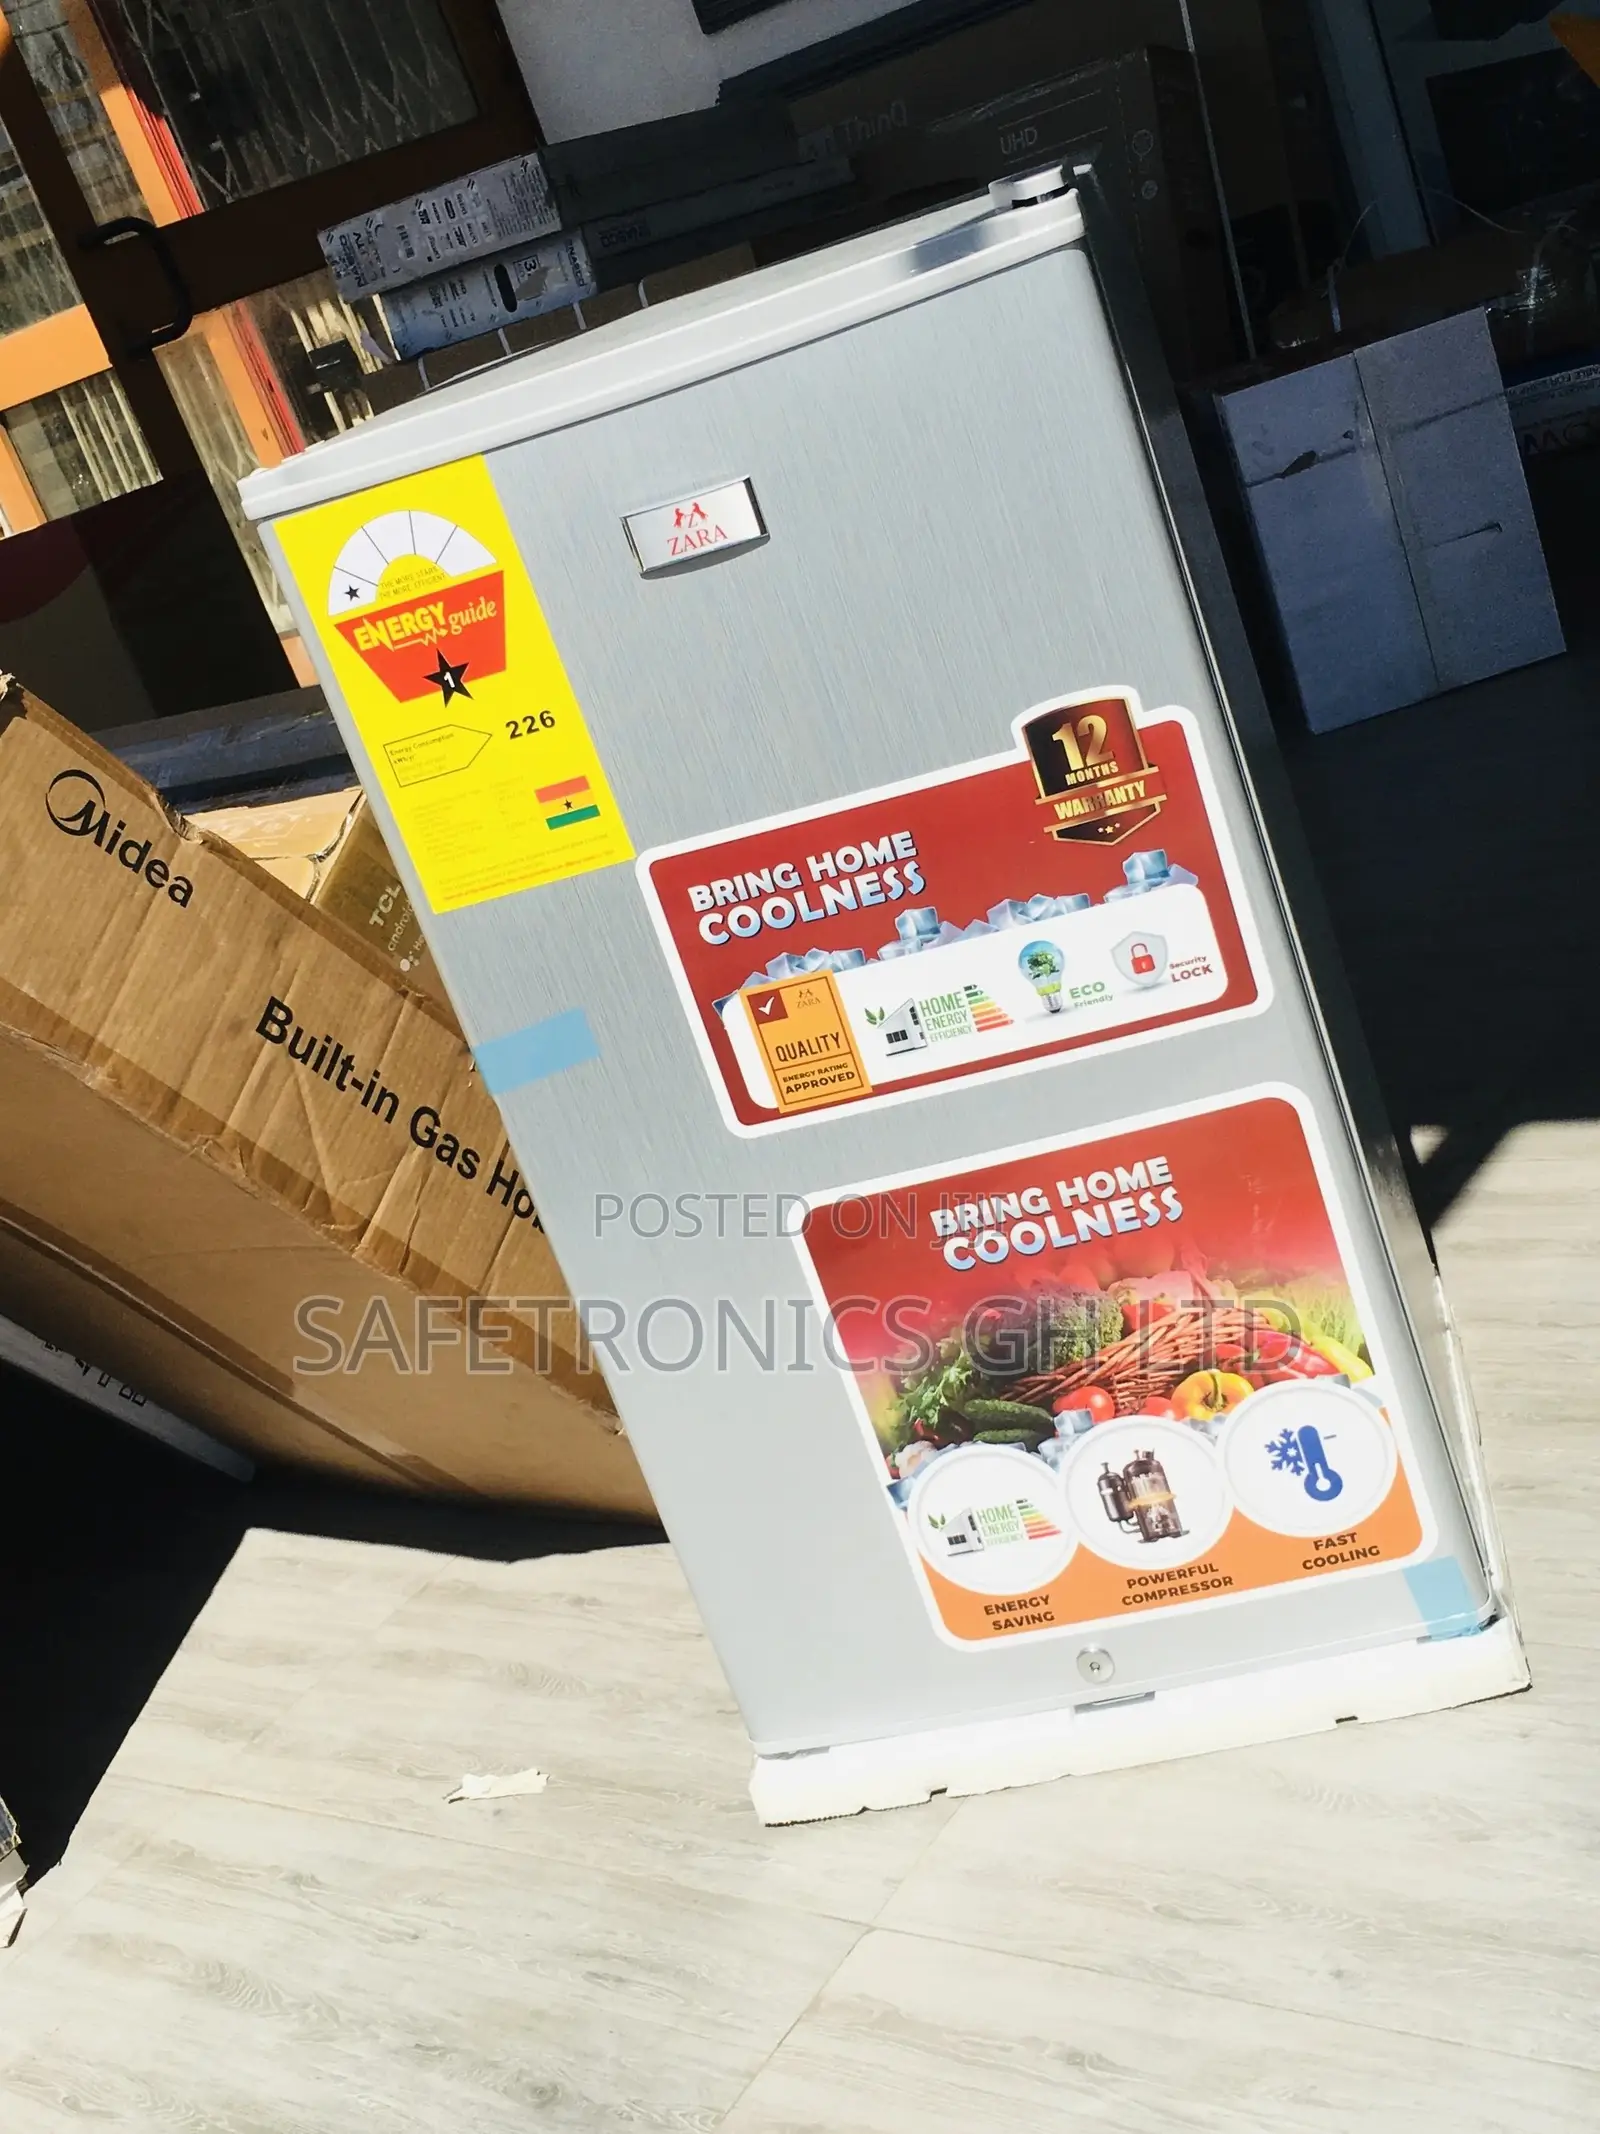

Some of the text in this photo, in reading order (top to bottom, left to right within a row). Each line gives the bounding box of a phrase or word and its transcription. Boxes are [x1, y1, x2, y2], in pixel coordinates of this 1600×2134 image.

[1000, 127, 1038, 155] UHD
[667, 524, 728, 556] ZARA
[379, 573, 445, 600] THE MORE EFFICIENT
[380, 580, 394, 590] THE
[396, 573, 414, 584] MORE
[353, 596, 497, 652] ENERGY guide
[443, 672, 456, 688] 1
[505, 710, 556, 739] 226
[390, 745, 412, 756] Energy
[1052, 714, 1116, 771] 12
[1065, 761, 1119, 786] MONTHS
[1054, 780, 1146, 820] WARRANTY
[45, 769, 194, 908] Midea
[687, 831, 918, 912] BRING HOME
[369, 885, 402, 927] TCL
[698, 861, 926, 945] COOLNESS
[1169, 955, 1207, 970] Security
[1171, 964, 1213, 983] LOCK
[1069, 981, 1106, 1000] ECO
[1074, 993, 1114, 1009] Friendly
[919, 991, 966, 1018] HOME
[925, 1010, 969, 1031] ENERGY
[775, 1032, 842, 1062] QUALITY
[929, 1025, 973, 1043] EFFICIENCY
[782, 1062, 849, 1083] ENERGY RATING
[785, 1071, 855, 1094] APPROVED
[255, 995, 545, 1234] Built-in Gas Ho
[930, 1156, 1173, 1237] BRING HOME
[943, 1186, 1184, 1271] COOLNESS
[976, 1504, 1017, 1524] HOME
[982, 1519, 1020, 1537] ENERGY
[1313, 1532, 1357, 1551] FAST
[1302, 1545, 1381, 1570] COOLING
[1127, 1562, 1220, 1589] POWERFUL
[1121, 1575, 1234, 1606] COMPRESSOR
[984, 1594, 1051, 1616] ENERGY
[992, 1611, 1055, 1631] SAVING
